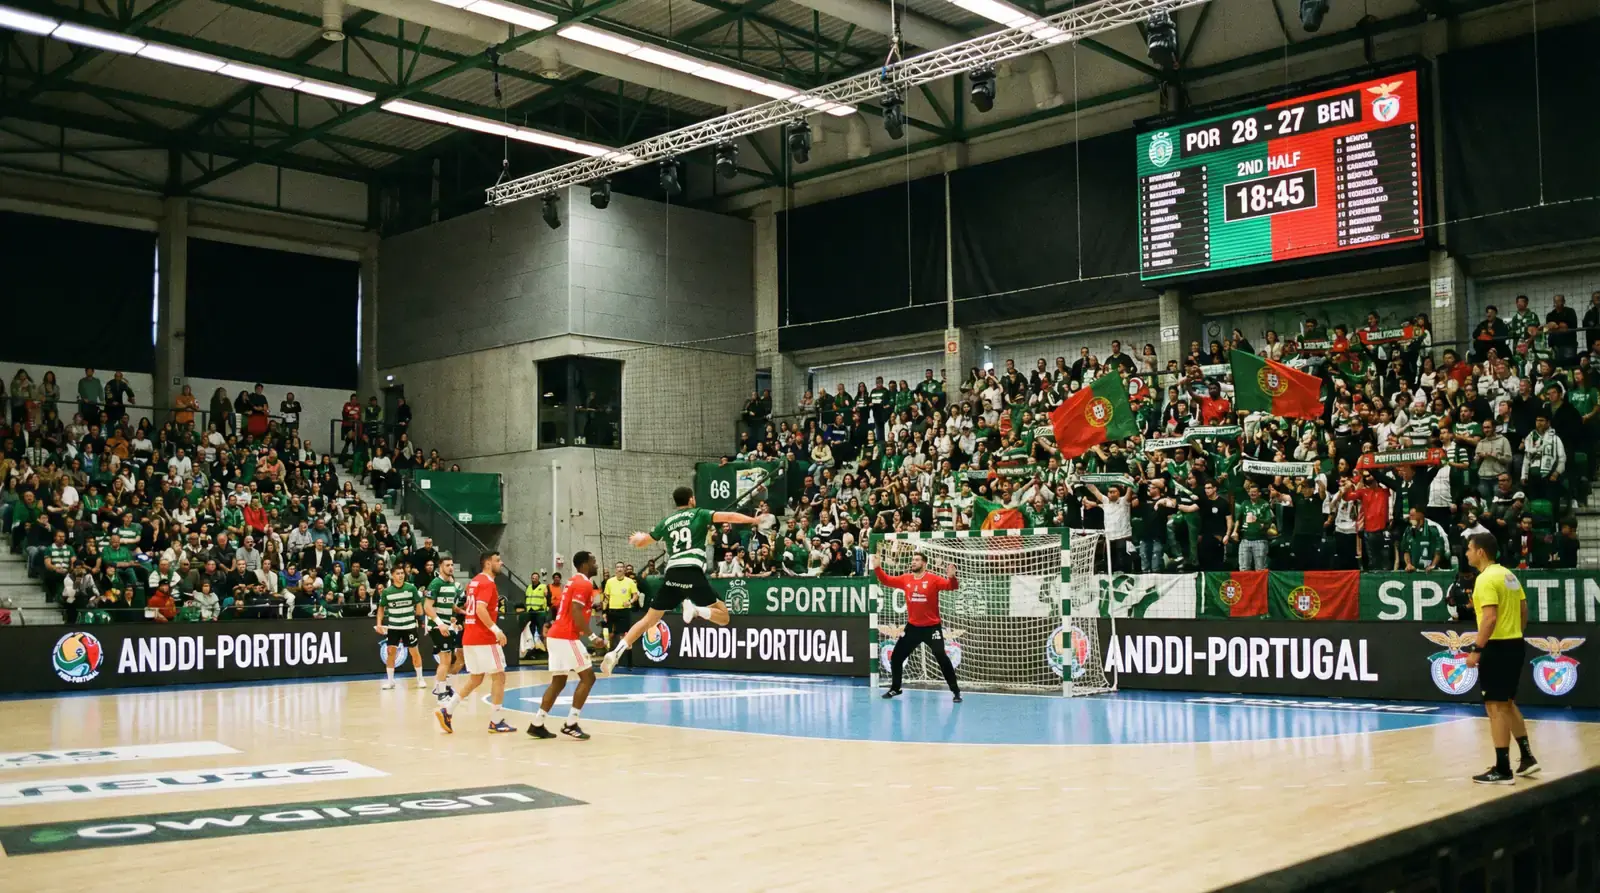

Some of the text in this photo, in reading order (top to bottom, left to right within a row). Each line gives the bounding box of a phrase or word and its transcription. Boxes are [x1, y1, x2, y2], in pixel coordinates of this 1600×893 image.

[1186, 128, 1221, 152] POR
[1232, 117, 1258, 144] 28
[1278, 107, 1305, 135] 27
[1317, 98, 1354, 124] BEN
[1237, 151, 1301, 177] 2ND HALF
[1237, 177, 1305, 213] 18:45
[669, 526, 692, 553] 29
[118, 631, 348, 674] ANDDI-PORTUGAL
[679, 626, 854, 663] ANDDI-PORTUGAL
[1104, 634, 1379, 682] ANDDI-PORTUGAL
